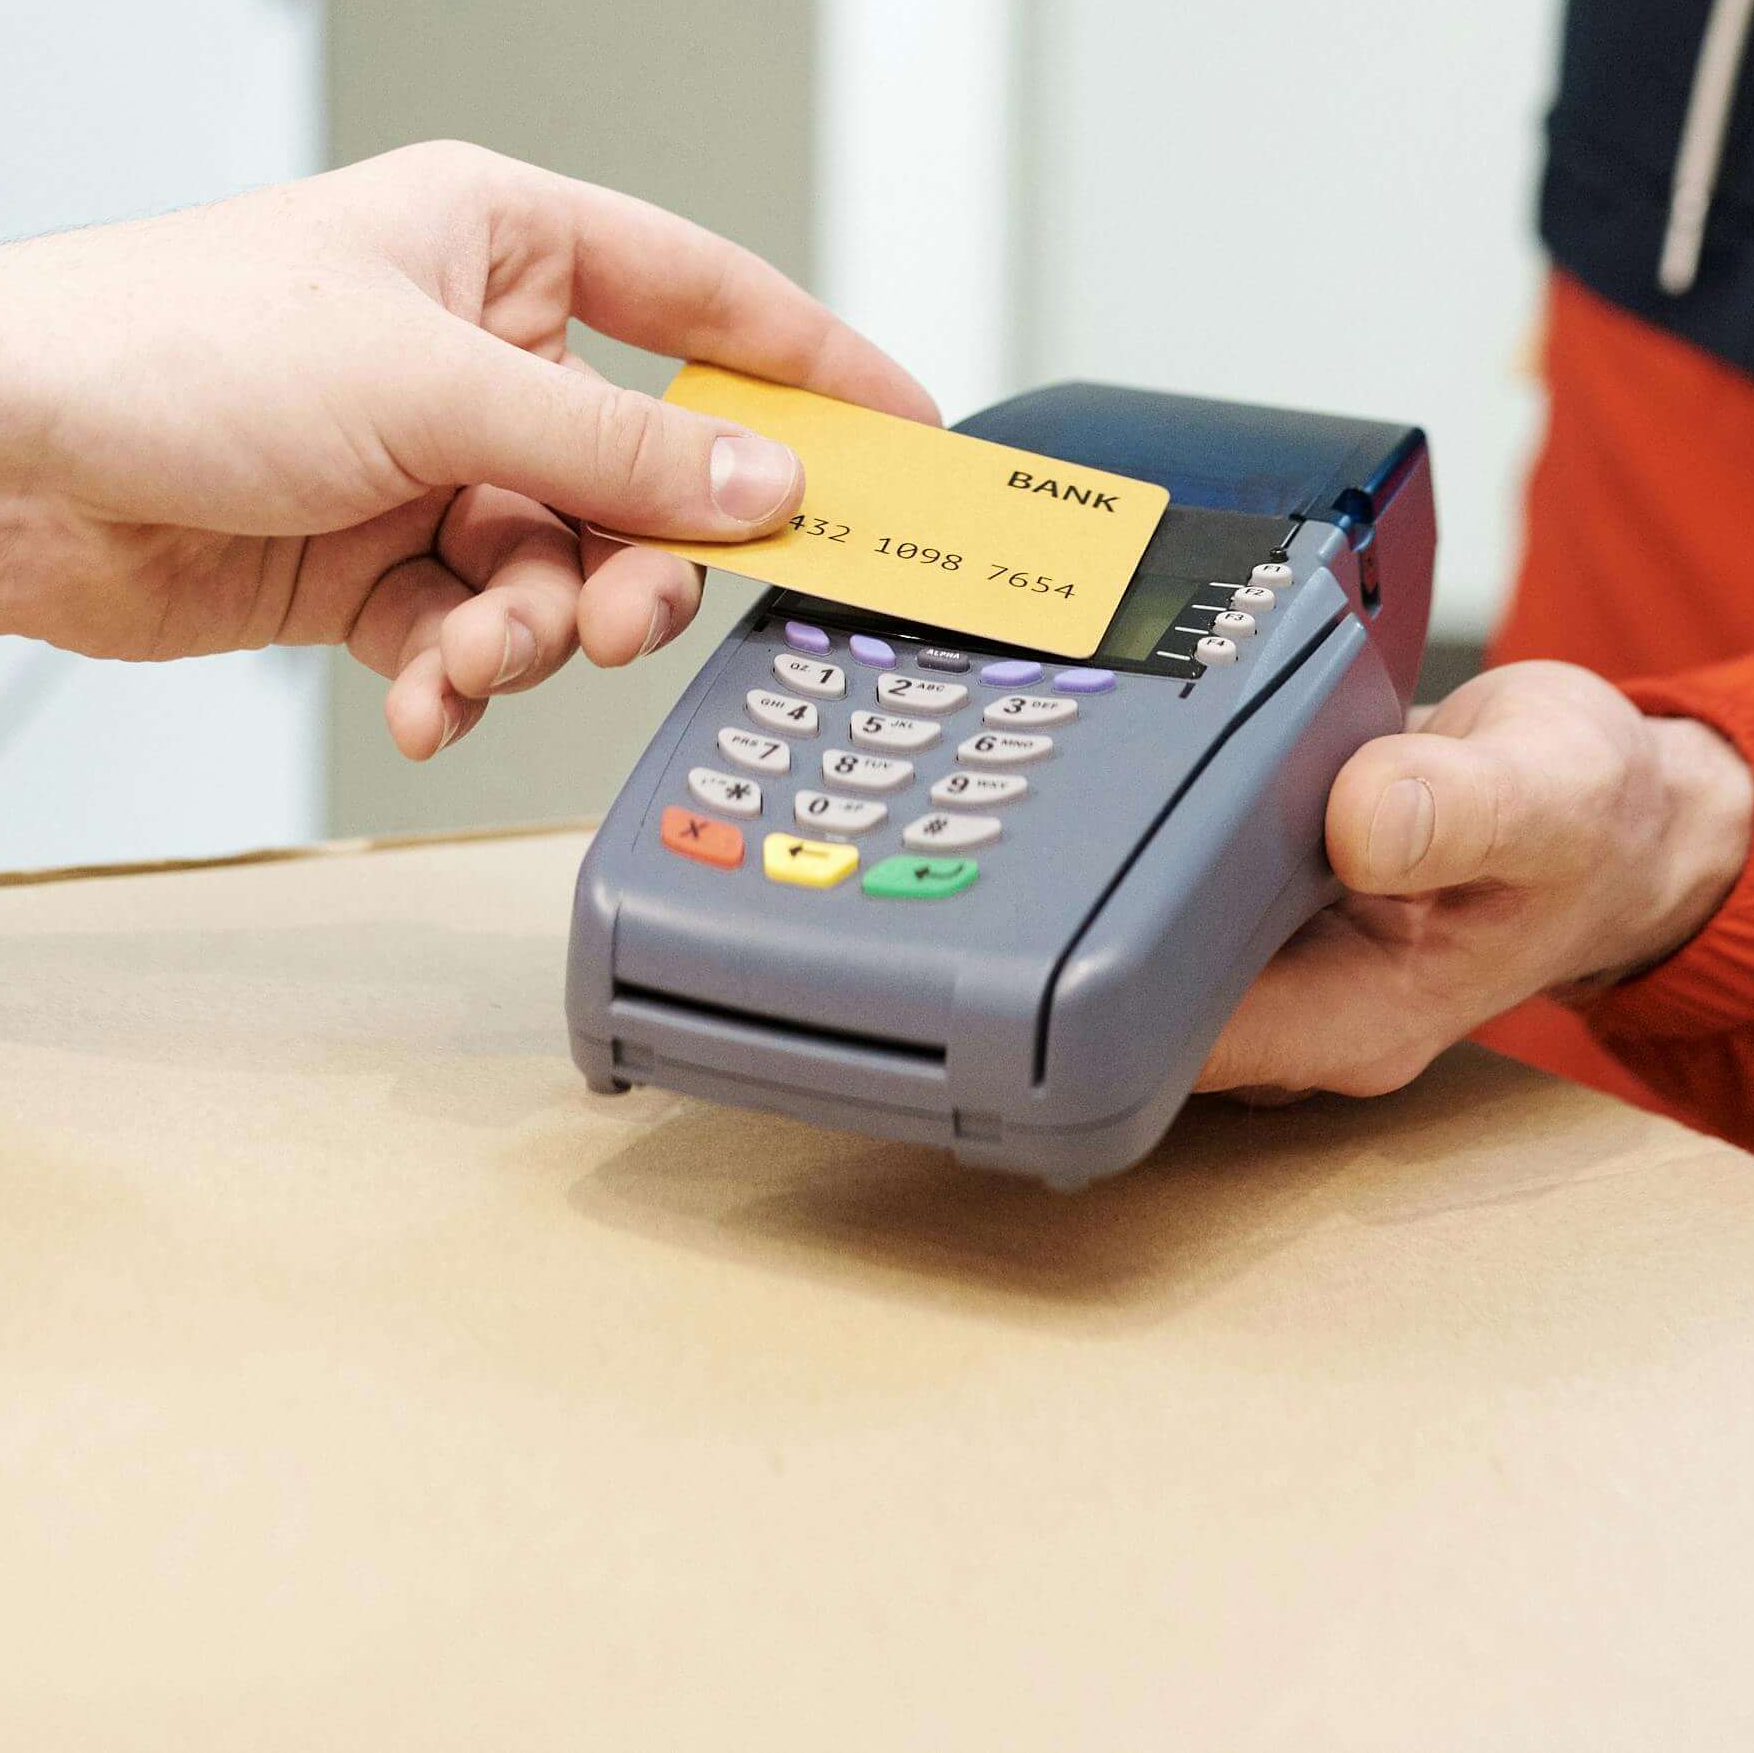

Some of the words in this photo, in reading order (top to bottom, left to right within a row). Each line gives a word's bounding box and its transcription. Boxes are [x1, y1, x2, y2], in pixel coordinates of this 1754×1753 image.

[1006, 470, 1122, 514] BANK
[788, 513, 851, 543] 432
[873, 536, 964, 572] 1098
[987, 564, 1079, 600] 7654
[1263, 565, 1282, 573] F1
[1245, 587, 1264, 597] F2
[1224, 612, 1245, 622] F3
[1206, 638, 1226, 647] F4
[926, 648, 961, 660] ALPHA
[819, 668, 835, 685] 1
[888, 678, 913, 697] 2
[916, 682, 946, 693] ABC
[760, 697, 785, 709] GHI
[787, 704, 809, 721] 4
[1003, 697, 1027, 715] 3
[862, 715, 886, 734] 5
[758, 742, 780, 760] 7
[974, 735, 998, 753] 6
[835, 754, 859, 774] 8
[946, 774, 971, 794] 9
[808, 797, 830, 815] 0
